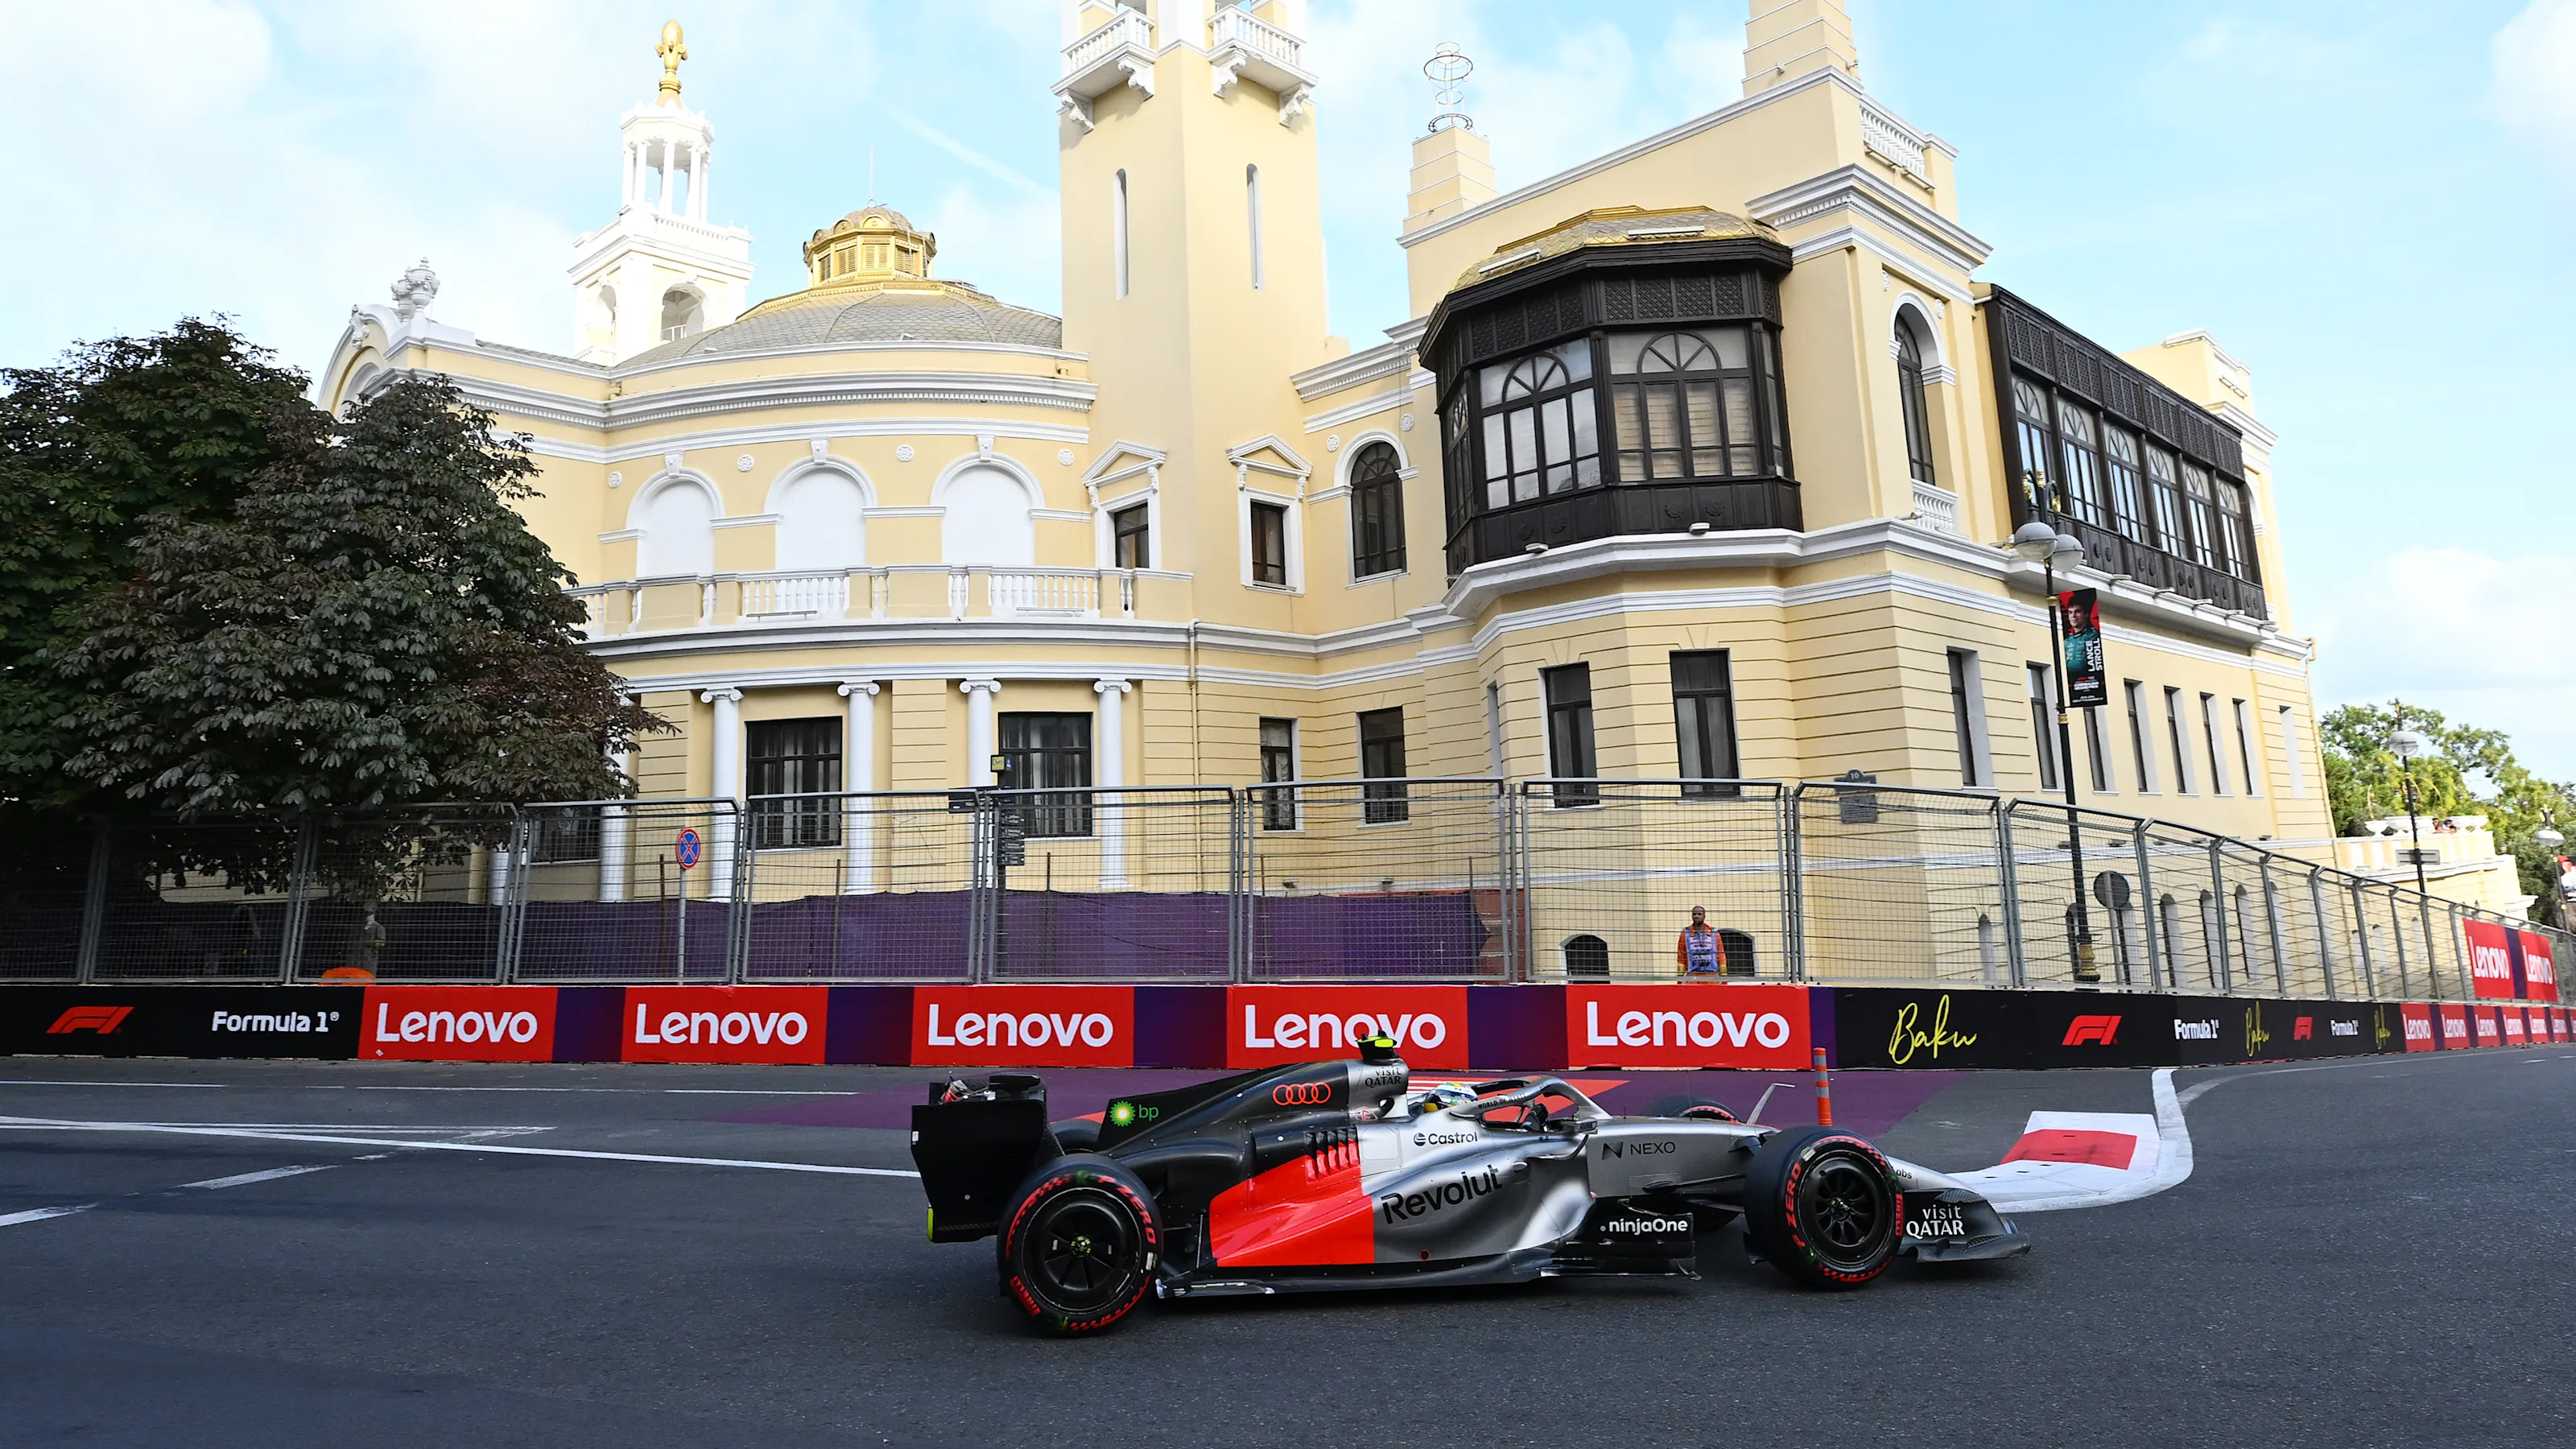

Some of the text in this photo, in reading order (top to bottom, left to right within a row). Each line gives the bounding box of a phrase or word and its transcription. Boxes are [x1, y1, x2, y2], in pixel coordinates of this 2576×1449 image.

[2086, 641, 2095, 672] LANCE
[2093, 638, 2103, 671] STROLL
[2468, 935, 2510, 980] Lenovo
[2522, 945, 2553, 985] Lenovo
[46, 1006, 134, 1034] F1
[211, 1010, 311, 1033] Formula
[376, 1002, 538, 1043] Lenovo
[635, 1003, 808, 1045] Lenovo
[928, 1004, 1113, 1047] Lenovo
[1245, 1004, 1446, 1049] Lenovo
[1587, 1001, 1790, 1048] Lenovo
[1889, 994, 1977, 1065] Baku
[2062, 1015, 2122, 1046] F1
[2174, 1019, 2211, 1040] Formula
[2403, 1013, 2431, 1040] Lenovo
[1364, 1075, 1402, 1088] QATAR
[1376, 1066, 1402, 1076] visit
[1138, 1104, 1159, 1121] bp
[1478, 1100, 1497, 1108] WORLD
[1429, 1132, 1478, 1145] Castrol
[1630, 1141, 1676, 1155] NEXO
[1381, 1165, 1502, 1224] Revolut
[1785, 1162, 1802, 1228] ZERO
[1116, 1184, 1157, 1245] ZERO
[1608, 1218, 1688, 1236] ninjaOne
[1922, 1204, 1962, 1220] visit
[1906, 1220, 1965, 1240] QATAR
